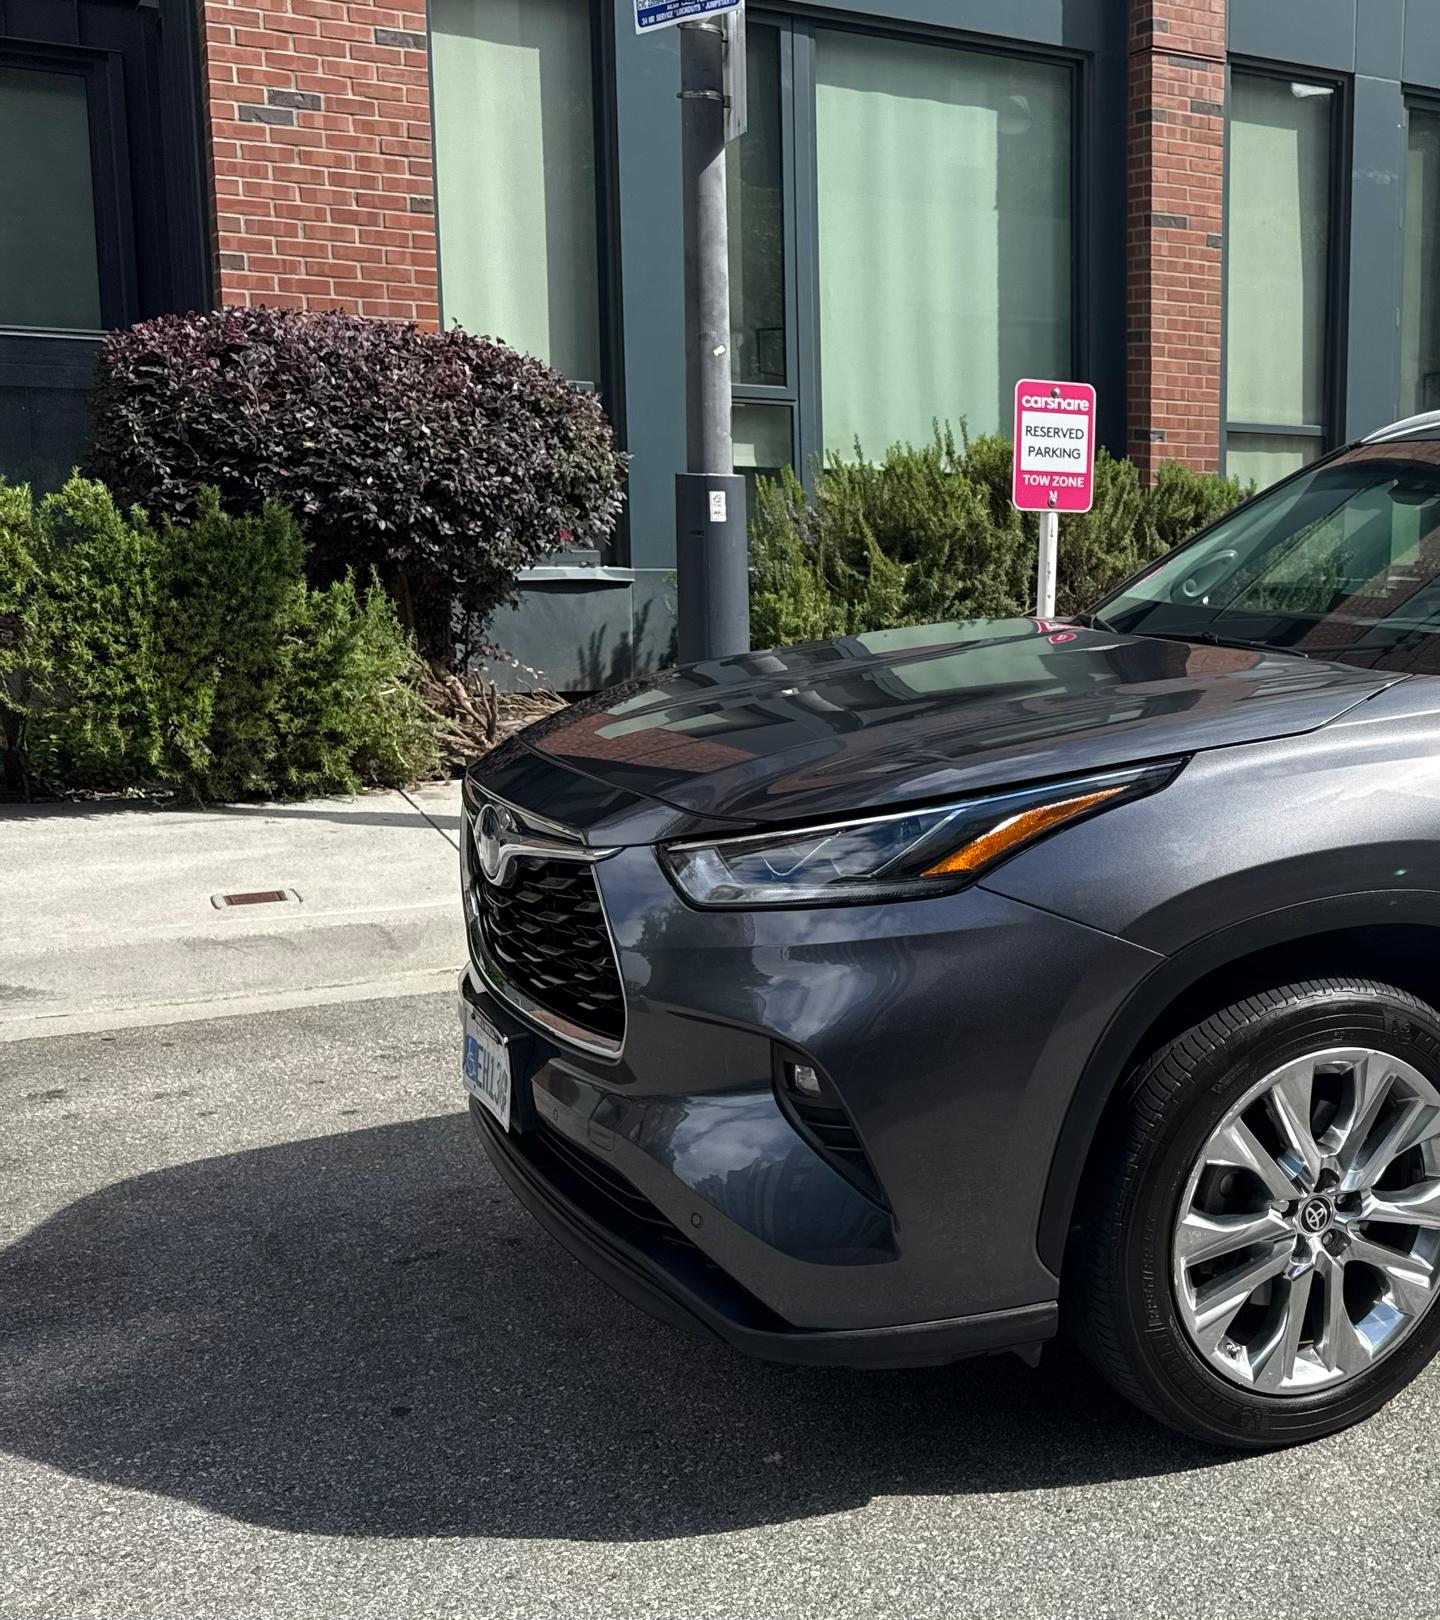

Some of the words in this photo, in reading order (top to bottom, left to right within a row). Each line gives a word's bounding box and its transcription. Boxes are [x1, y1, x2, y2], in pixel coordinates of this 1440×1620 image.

[656, 11, 674, 21] SERVICE
[1021, 395, 1090, 412] carshare
[1025, 425, 1085, 440] RESERVED
[1028, 445, 1081, 460] PARKING
[1023, 474, 1050, 487] TOW
[1052, 476, 1085, 488] ZONE
